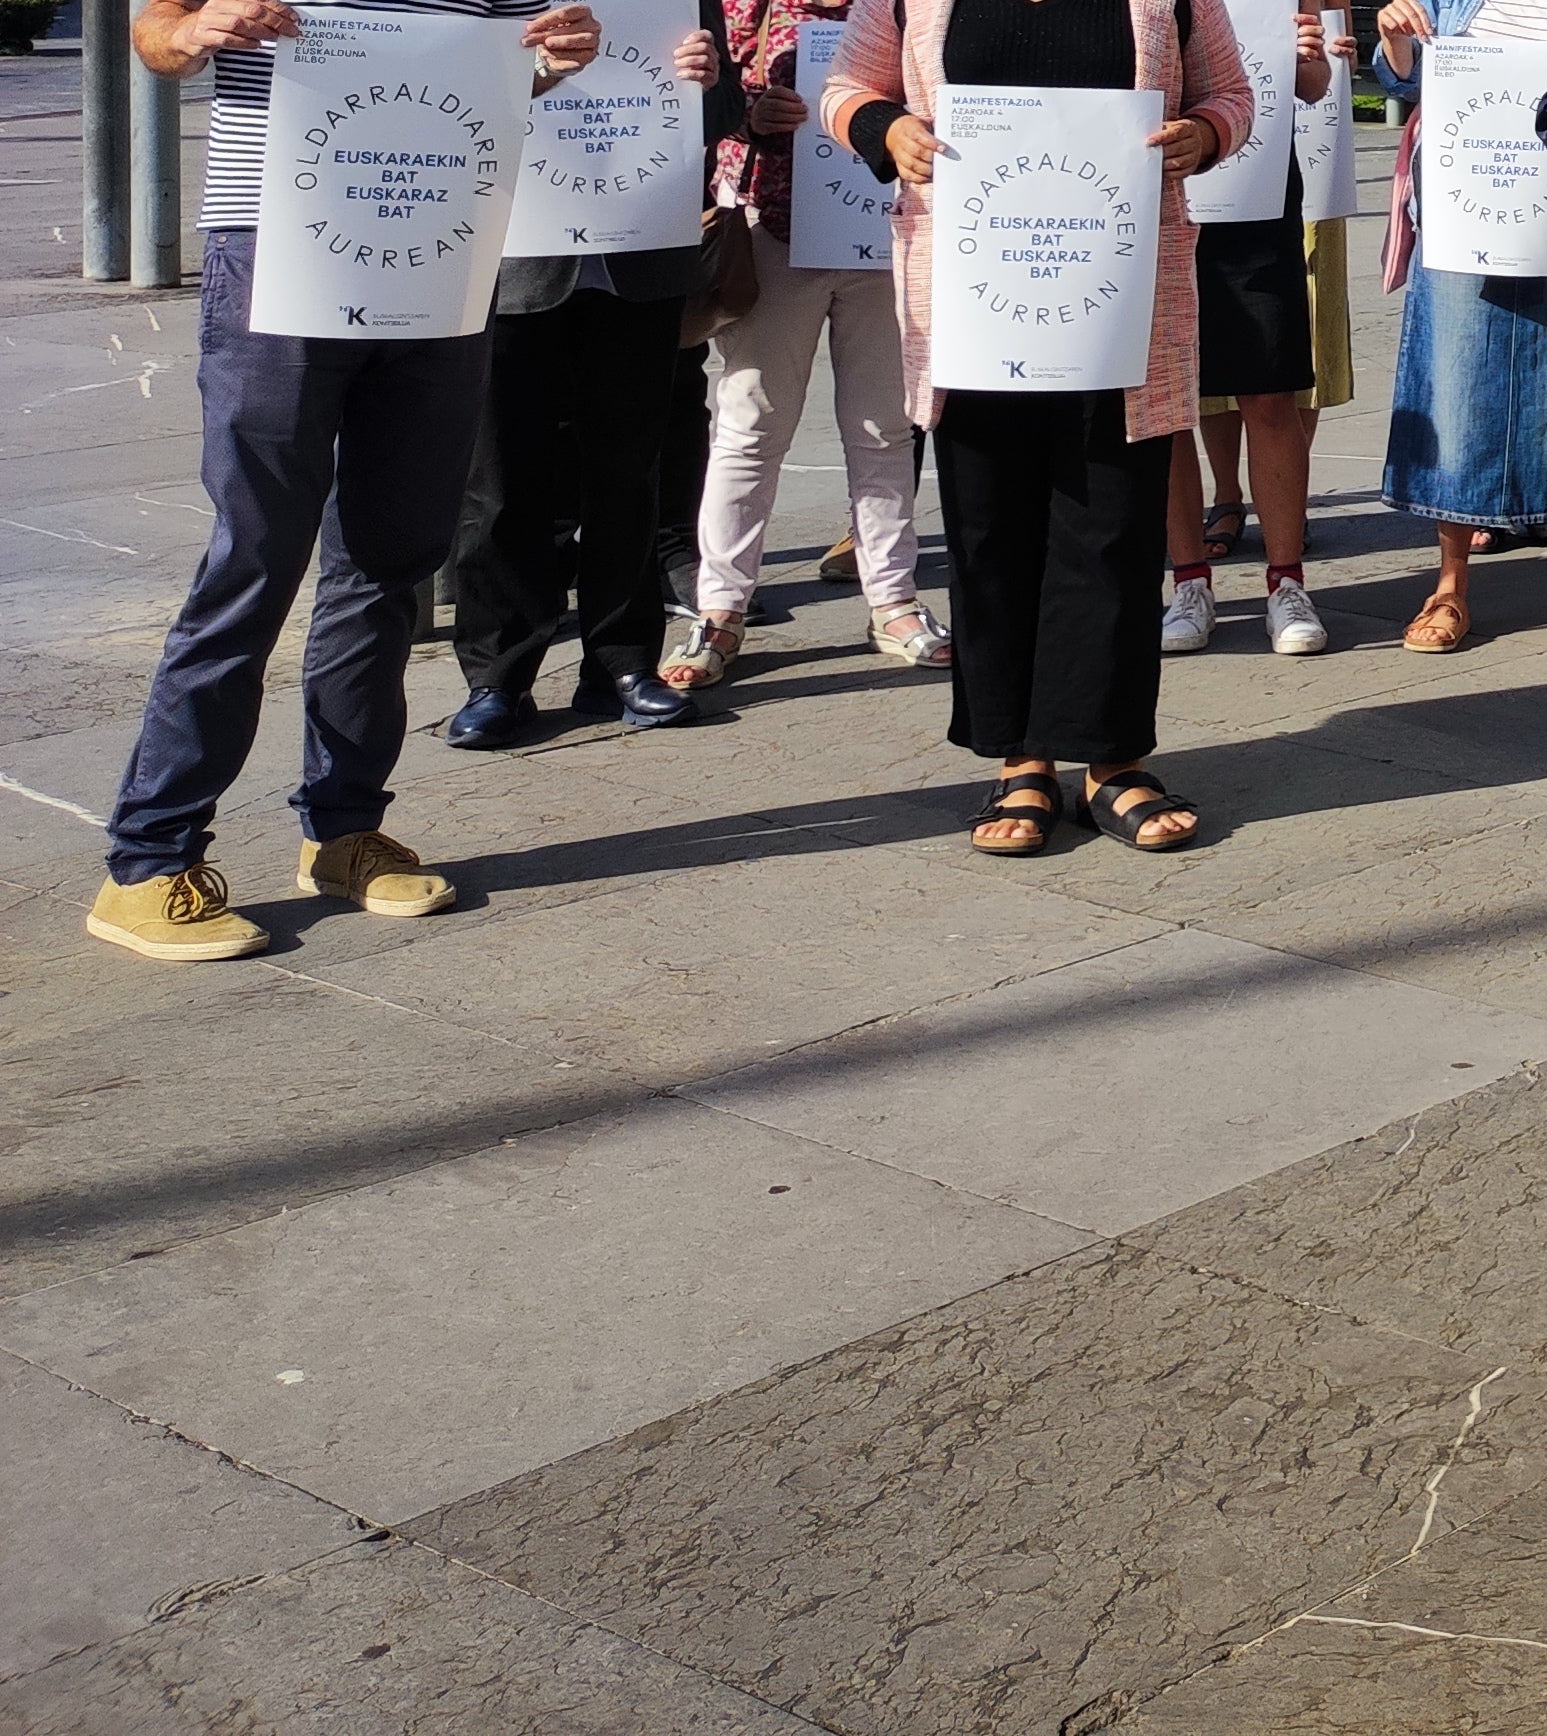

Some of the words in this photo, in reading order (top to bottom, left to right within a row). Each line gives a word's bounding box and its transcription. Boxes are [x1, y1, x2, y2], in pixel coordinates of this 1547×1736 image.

[296, 18, 403, 34] MANIFESTAZIOA
[295, 38, 324, 48] 17:00
[1435, 44, 1504, 54] MANIFESTAZIOA
[294, 47, 367, 58] EUSKALDUNA
[294, 54, 327, 65] BILBO
[543, 96, 651, 111] EUSKARAEKIN
[951, 96, 1043, 107] MANIFESTAZIOA
[583, 112, 613, 124] BAT
[558, 126, 641, 140] EUSKARAZ
[951, 123, 1012, 131] EUSKALDUNA
[295, 83, 498, 197] OLDARRALDIAREN
[585, 141, 614, 153] BAT
[333, 150, 467, 168] EUSKARAEKIN
[1493, 153, 1518, 163] BAT
[381, 170, 419, 184] BAT
[528, 150, 670, 195] AURREAN
[1471, 165, 1539, 177] EUSKARAZ
[1492, 178, 1517, 189] BAT
[346, 186, 449, 202] EUSKARAZ
[377, 205, 415, 219] BAT
[958, 153, 1135, 258] OLDARRALDIAREN
[989, 217, 1105, 231] EUSKARAEKIN
[305, 220, 475, 269] AURREAN
[1031, 234, 1064, 247] BAT
[1001, 250, 1092, 263] EUSKARAZ
[1030, 266, 1063, 279] BAT
[968, 279, 1119, 325] AURREAN
